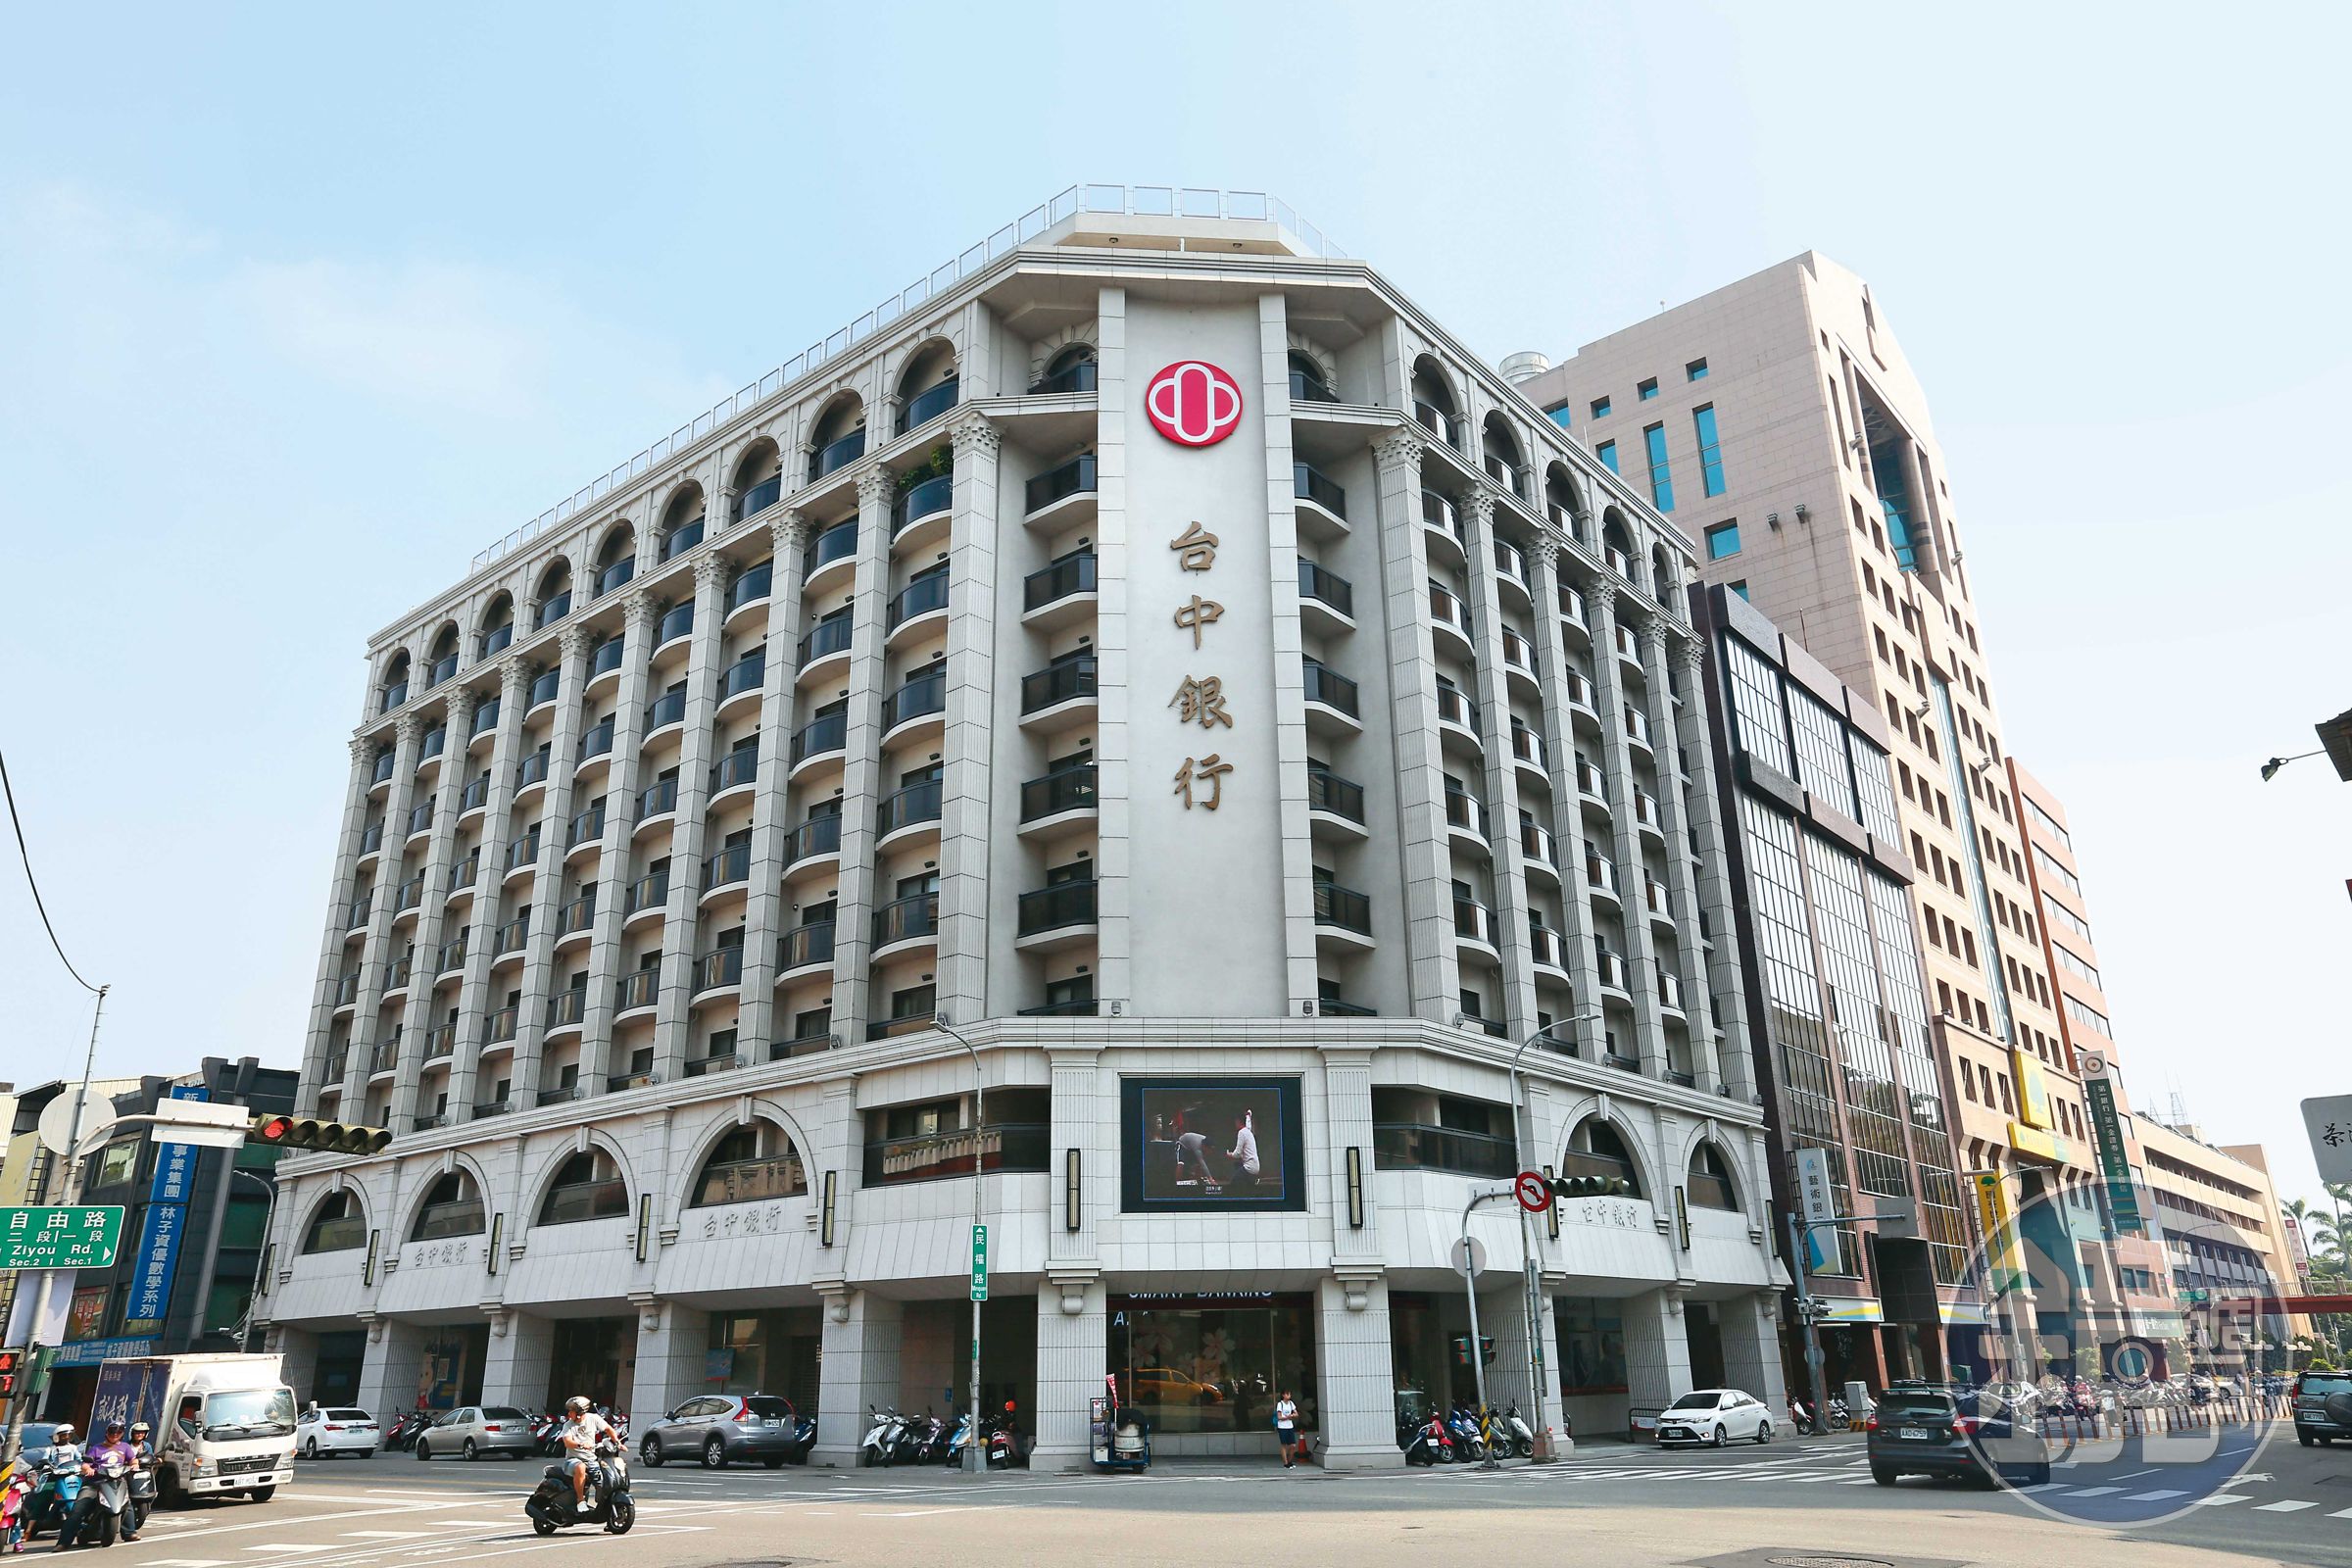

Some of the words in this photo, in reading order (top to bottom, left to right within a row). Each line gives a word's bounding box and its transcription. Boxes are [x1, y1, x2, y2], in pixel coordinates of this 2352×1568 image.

[1167, 520, 1234, 810] 台中銀行
[2323, 1123, 2352, 1148] 茶
[1808, 1175, 1824, 1220] 藝術銀
[10, 1211, 107, 1229] 自由路
[705, 1205, 782, 1238] 台中銀行
[1582, 1200, 1638, 1228] 台中銀行
[12, 1245, 56, 1257] Ziyou
[71, 1244, 94, 1254] Rd.
[139, 1206, 176, 1317] 林子資優數學系列
[416, 1242, 467, 1267] 台中銀行
[975, 1235, 985, 1284] 民權路
